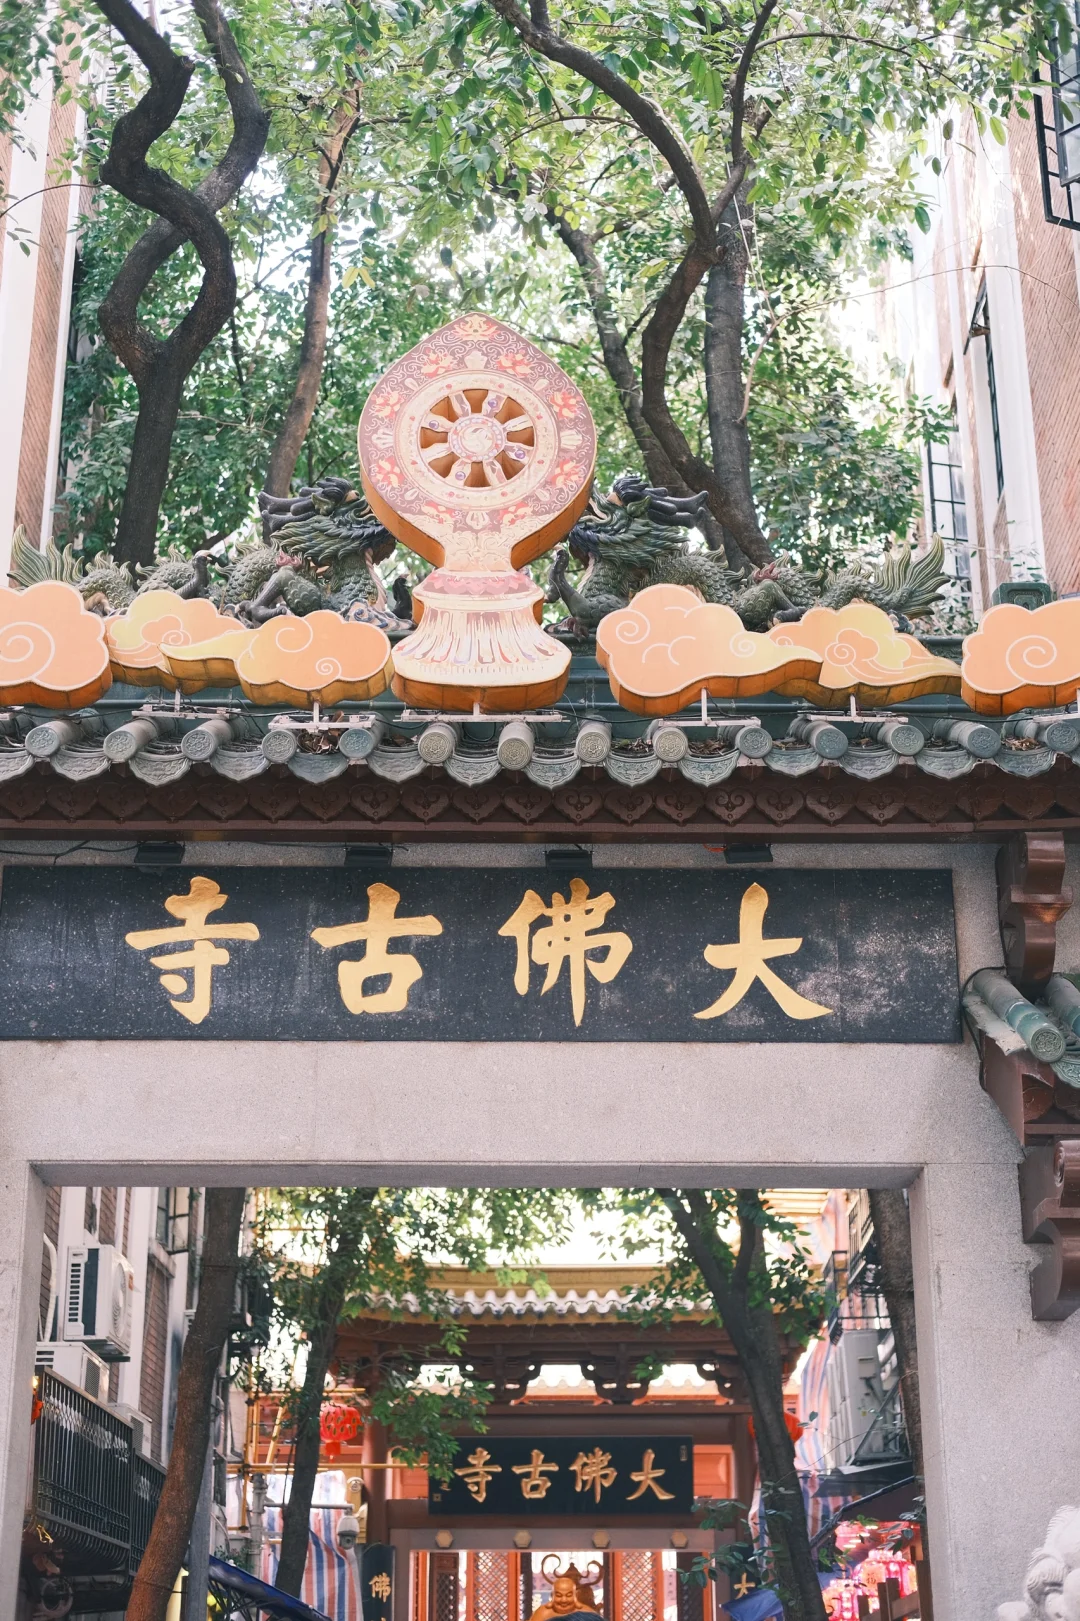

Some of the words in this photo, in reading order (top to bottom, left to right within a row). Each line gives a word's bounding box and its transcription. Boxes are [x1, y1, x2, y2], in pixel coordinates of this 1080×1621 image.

[125, 875, 833, 1026] 大佛古寺
[454, 1447, 675, 1503] 大佛古寺
